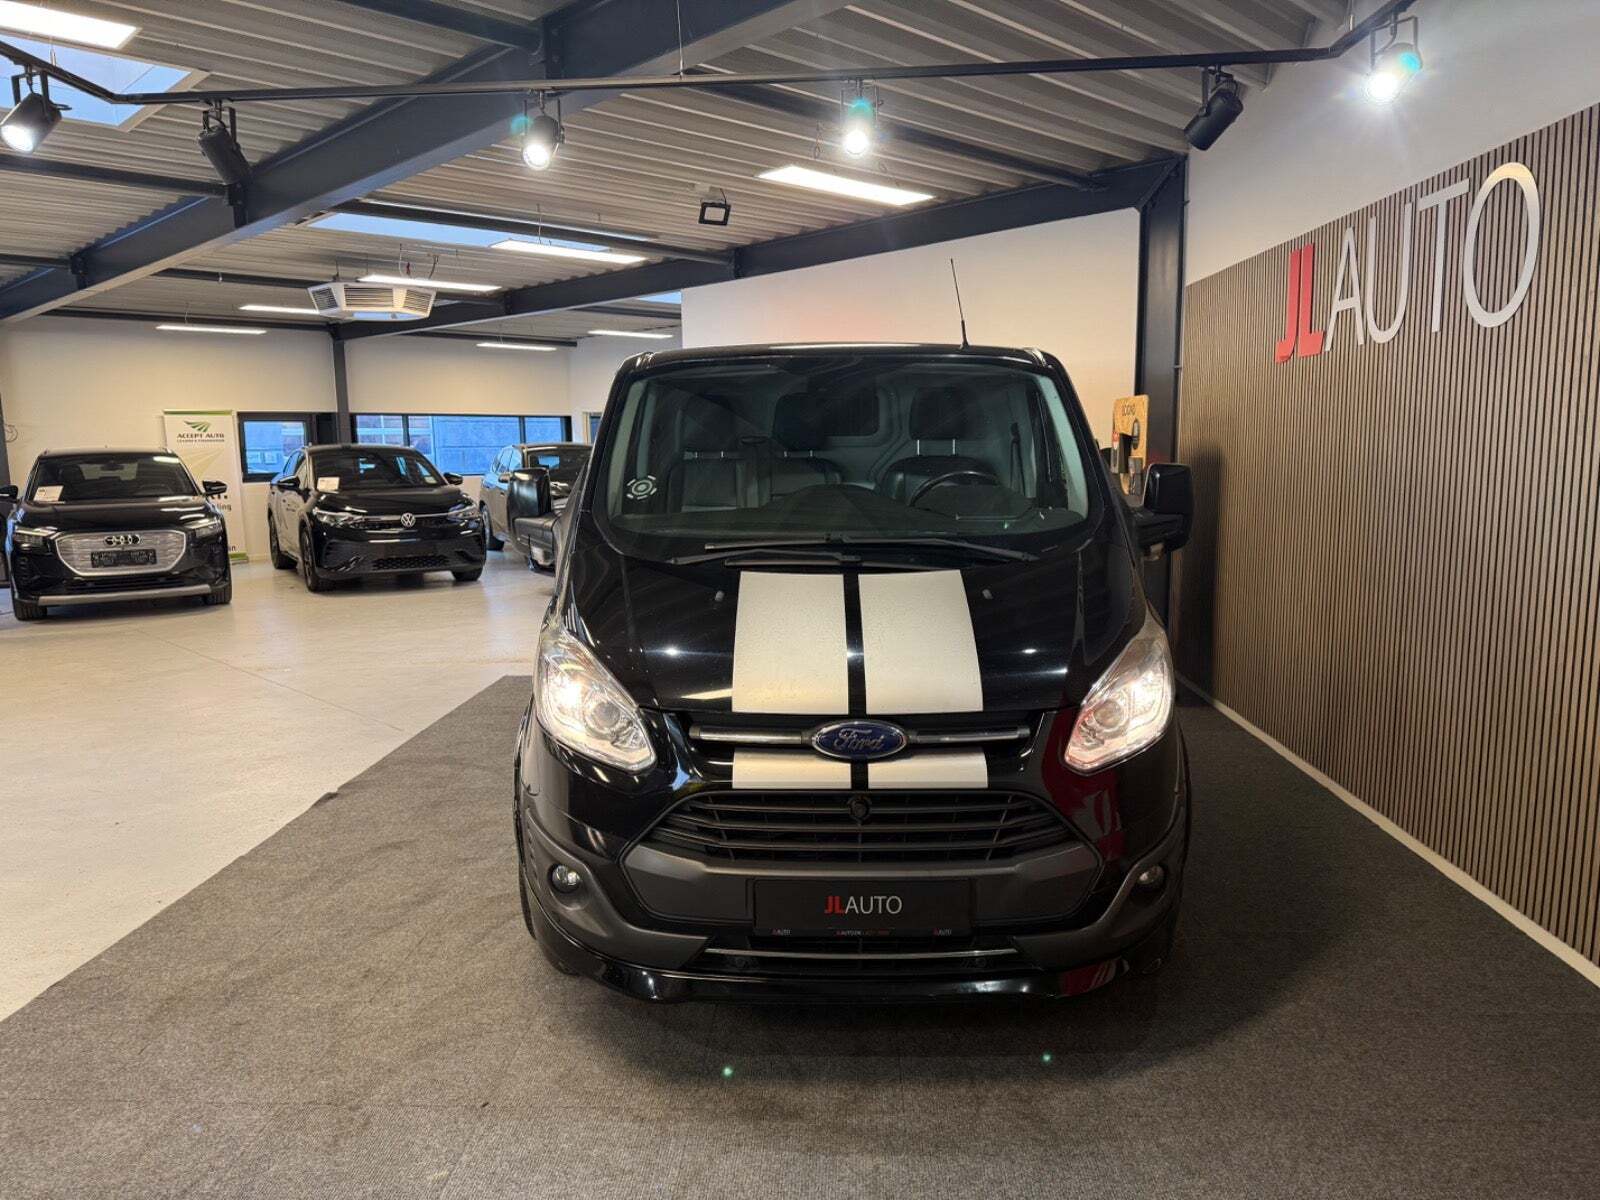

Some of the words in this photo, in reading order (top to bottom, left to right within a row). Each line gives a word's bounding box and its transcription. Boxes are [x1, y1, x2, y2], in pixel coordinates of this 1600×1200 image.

[1275, 161, 1540, 364] JLAUTO
[834, 728, 885, 749] Ford
[824, 896, 903, 914] JLAUTO
